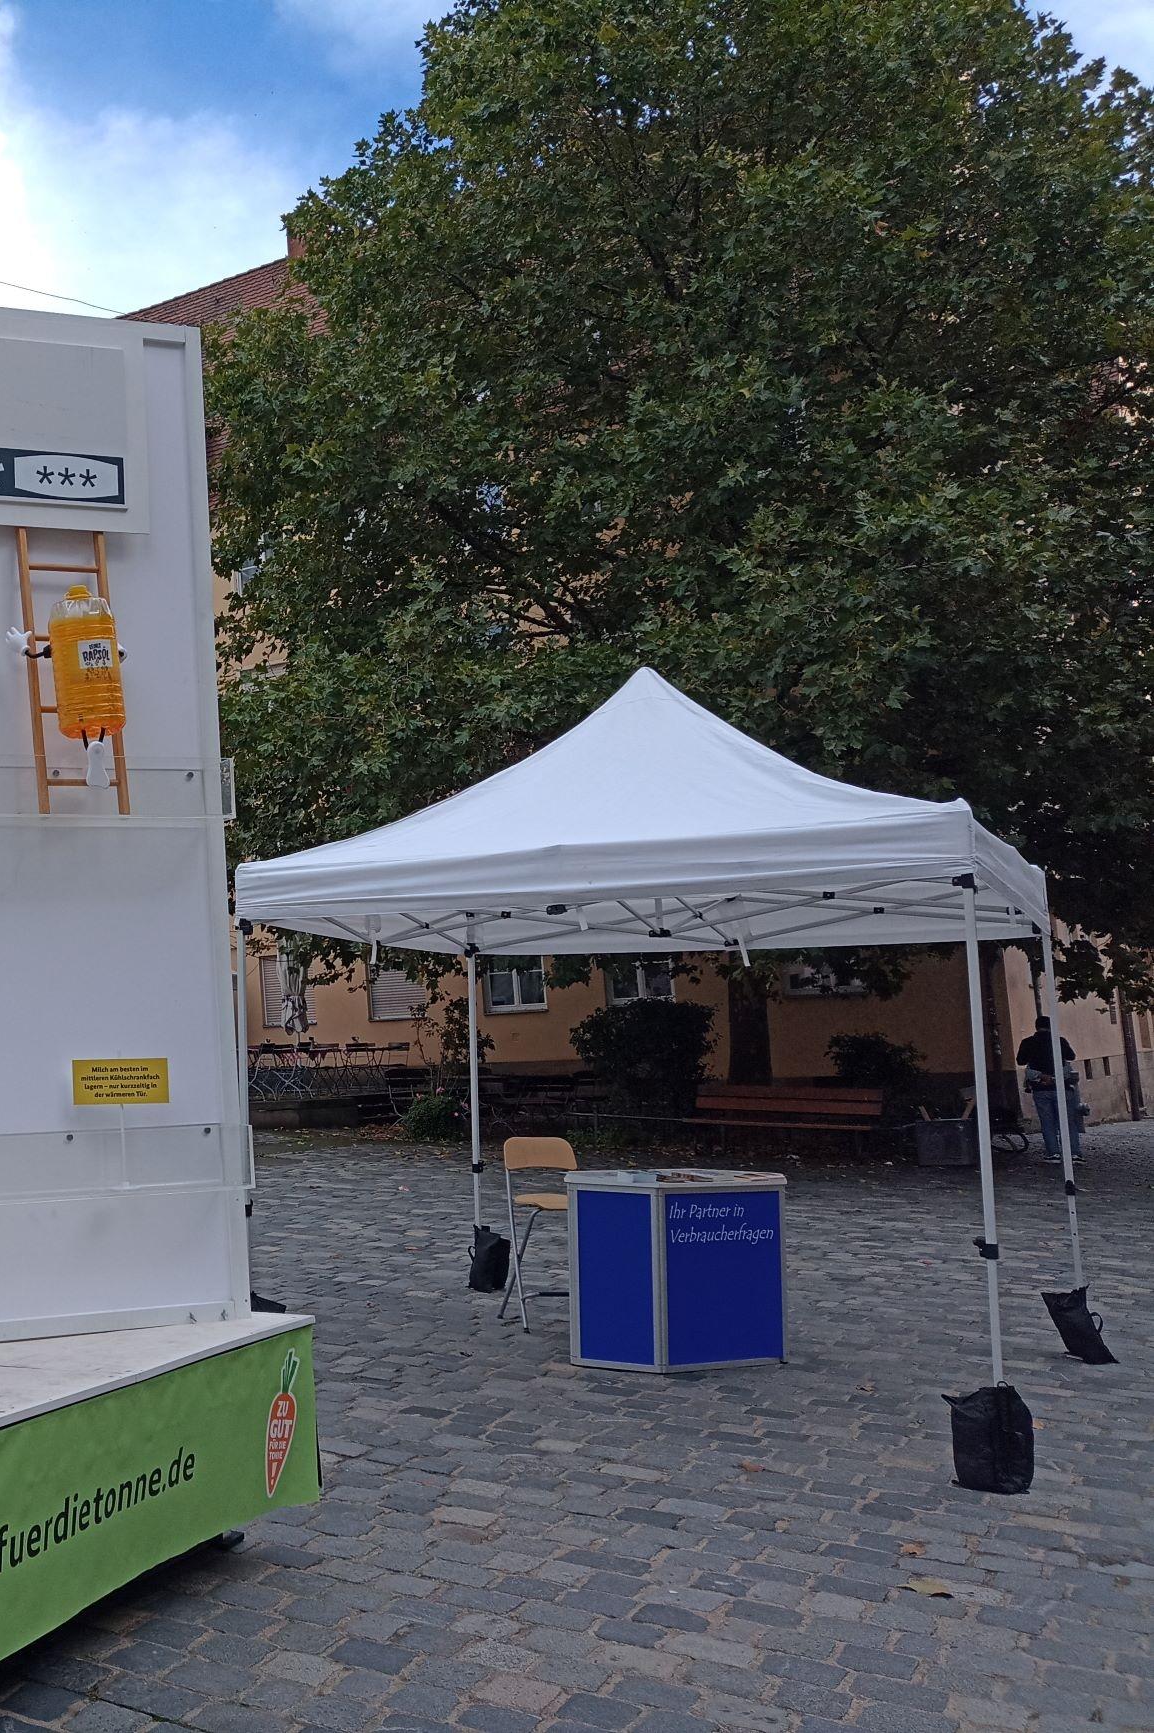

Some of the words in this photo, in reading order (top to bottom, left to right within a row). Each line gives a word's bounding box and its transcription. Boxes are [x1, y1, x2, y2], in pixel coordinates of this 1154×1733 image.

[670, 1202, 686, 1219] Ihr
[689, 1204, 731, 1219] Partner
[734, 1204, 744, 1218] in
[671, 1223, 774, 1244] Verbraucherfragen
[277, 1400, 289, 1417] ZU
[270, 1419, 292, 1439] GUT
